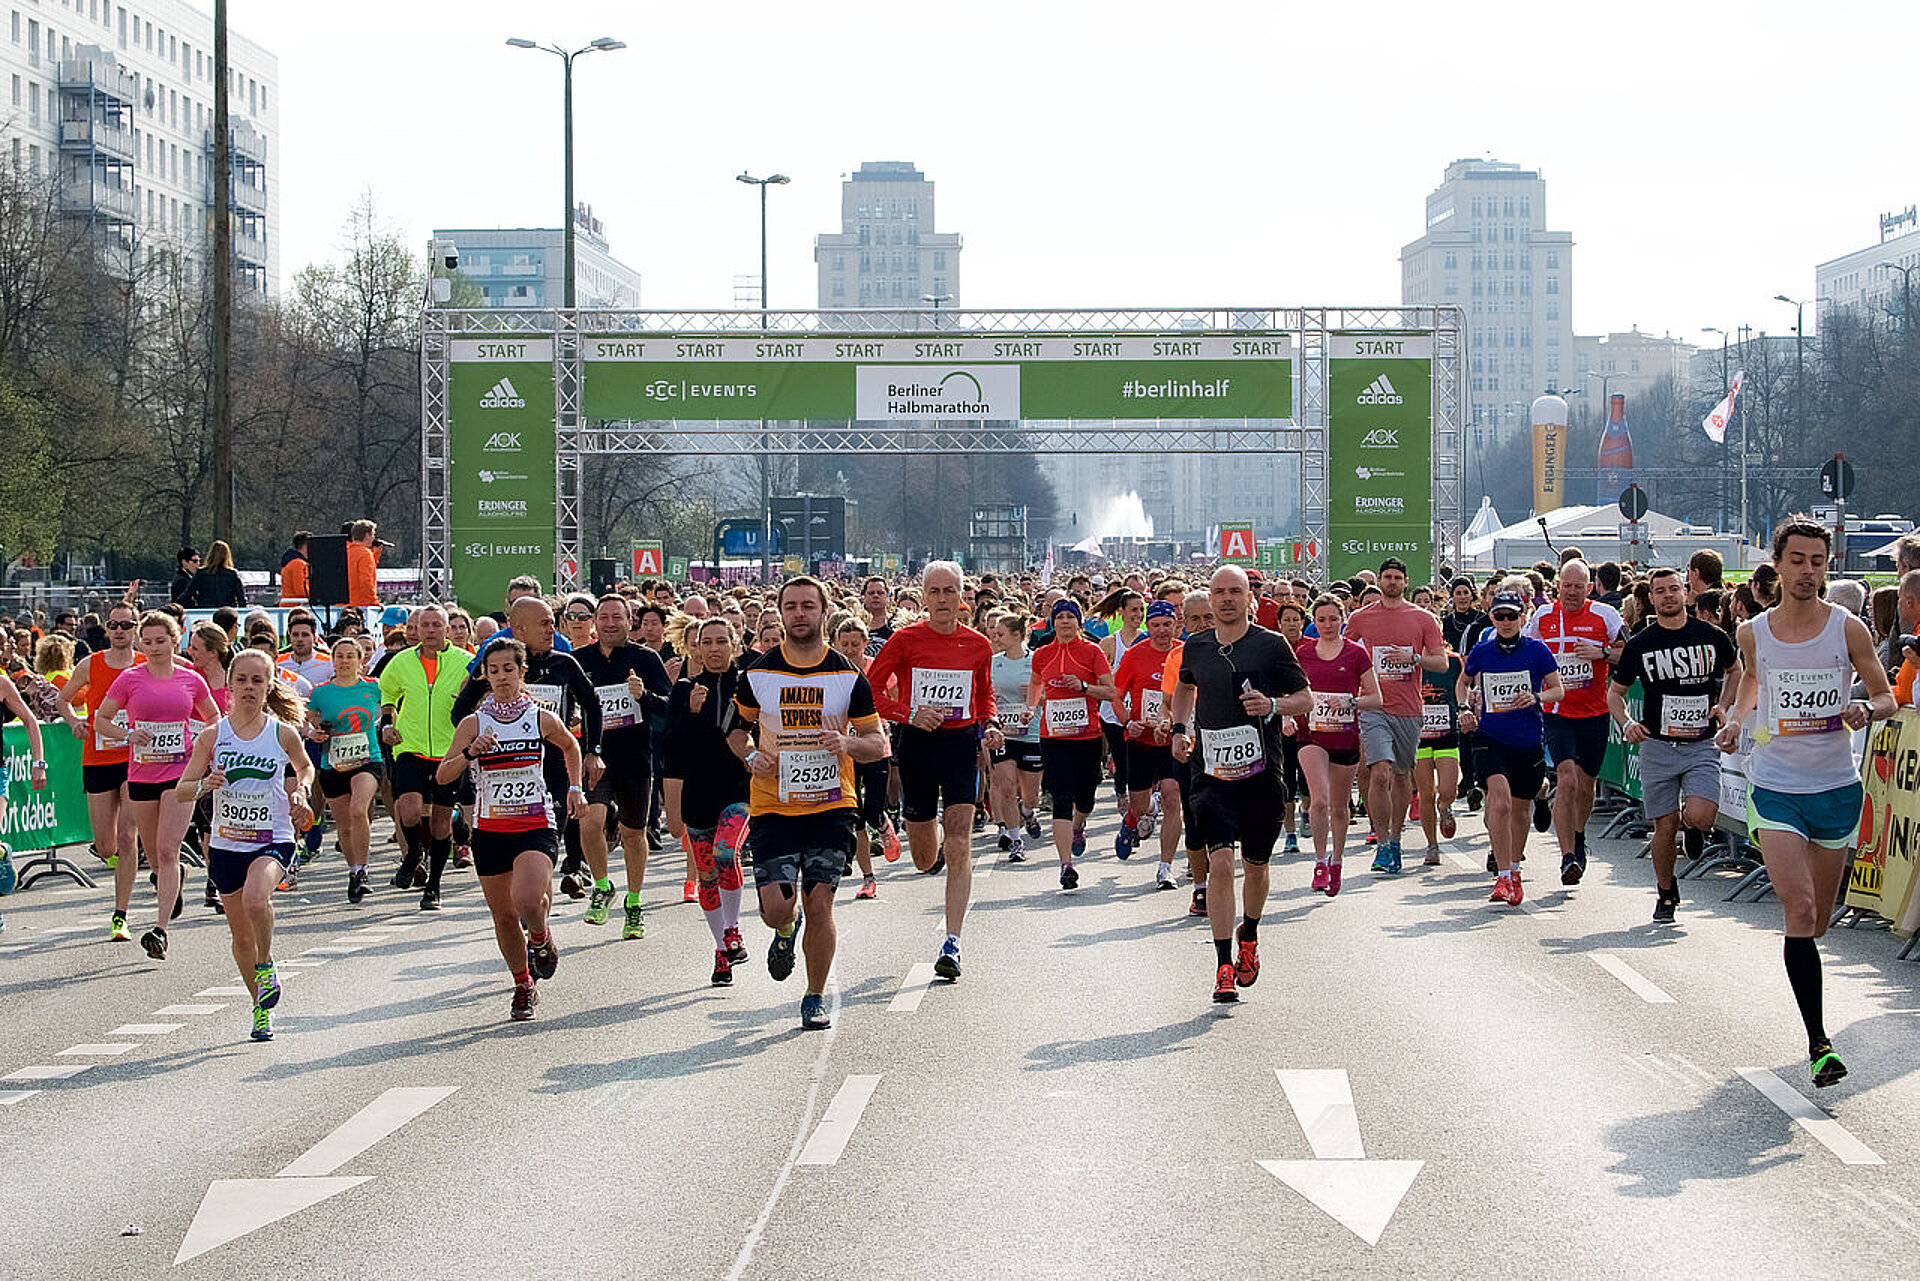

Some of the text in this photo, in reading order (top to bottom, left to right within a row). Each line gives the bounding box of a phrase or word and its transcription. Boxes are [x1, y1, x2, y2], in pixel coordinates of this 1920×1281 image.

[477, 344, 527, 358] START
[597, 341, 1281, 357] START START START START START START START START START
[1355, 341, 1405, 355] START
[645, 382, 757, 399] SCC EVENTS
[888, 384, 943, 397] Berliner
[1122, 379, 1230, 398] #berlinhalf
[479, 396, 526, 409] adidas
[1356, 392, 1403, 405] adidas
[888, 401, 990, 414] Halbmarathon
[484, 432, 521, 448] AOK
[1361, 429, 1399, 444] AOK
[478, 500, 528, 511] ERDINGER
[1355, 496, 1404, 508] ERDINGER
[496, 545, 541, 554] EVENTS
[1226, 532, 1248, 555] A
[1373, 542, 1418, 551] EVENTS
[638, 551, 658, 573] A
[1263, 552, 1272, 564] B
[672, 563, 682, 576] B
[779, 687, 824, 705] AMAZON
[921, 685, 963, 700] 11012
[1779, 688, 1838, 709] 33400
[780, 709, 823, 727] EXPRESS
[1052, 709, 1086, 722] 20269
[218, 750, 278, 770] Titans
[1213, 742, 1255, 763] 7788
[790, 764, 837, 783] 25320
[491, 782, 536, 799] 7332
[221, 803, 270, 821] 39058
